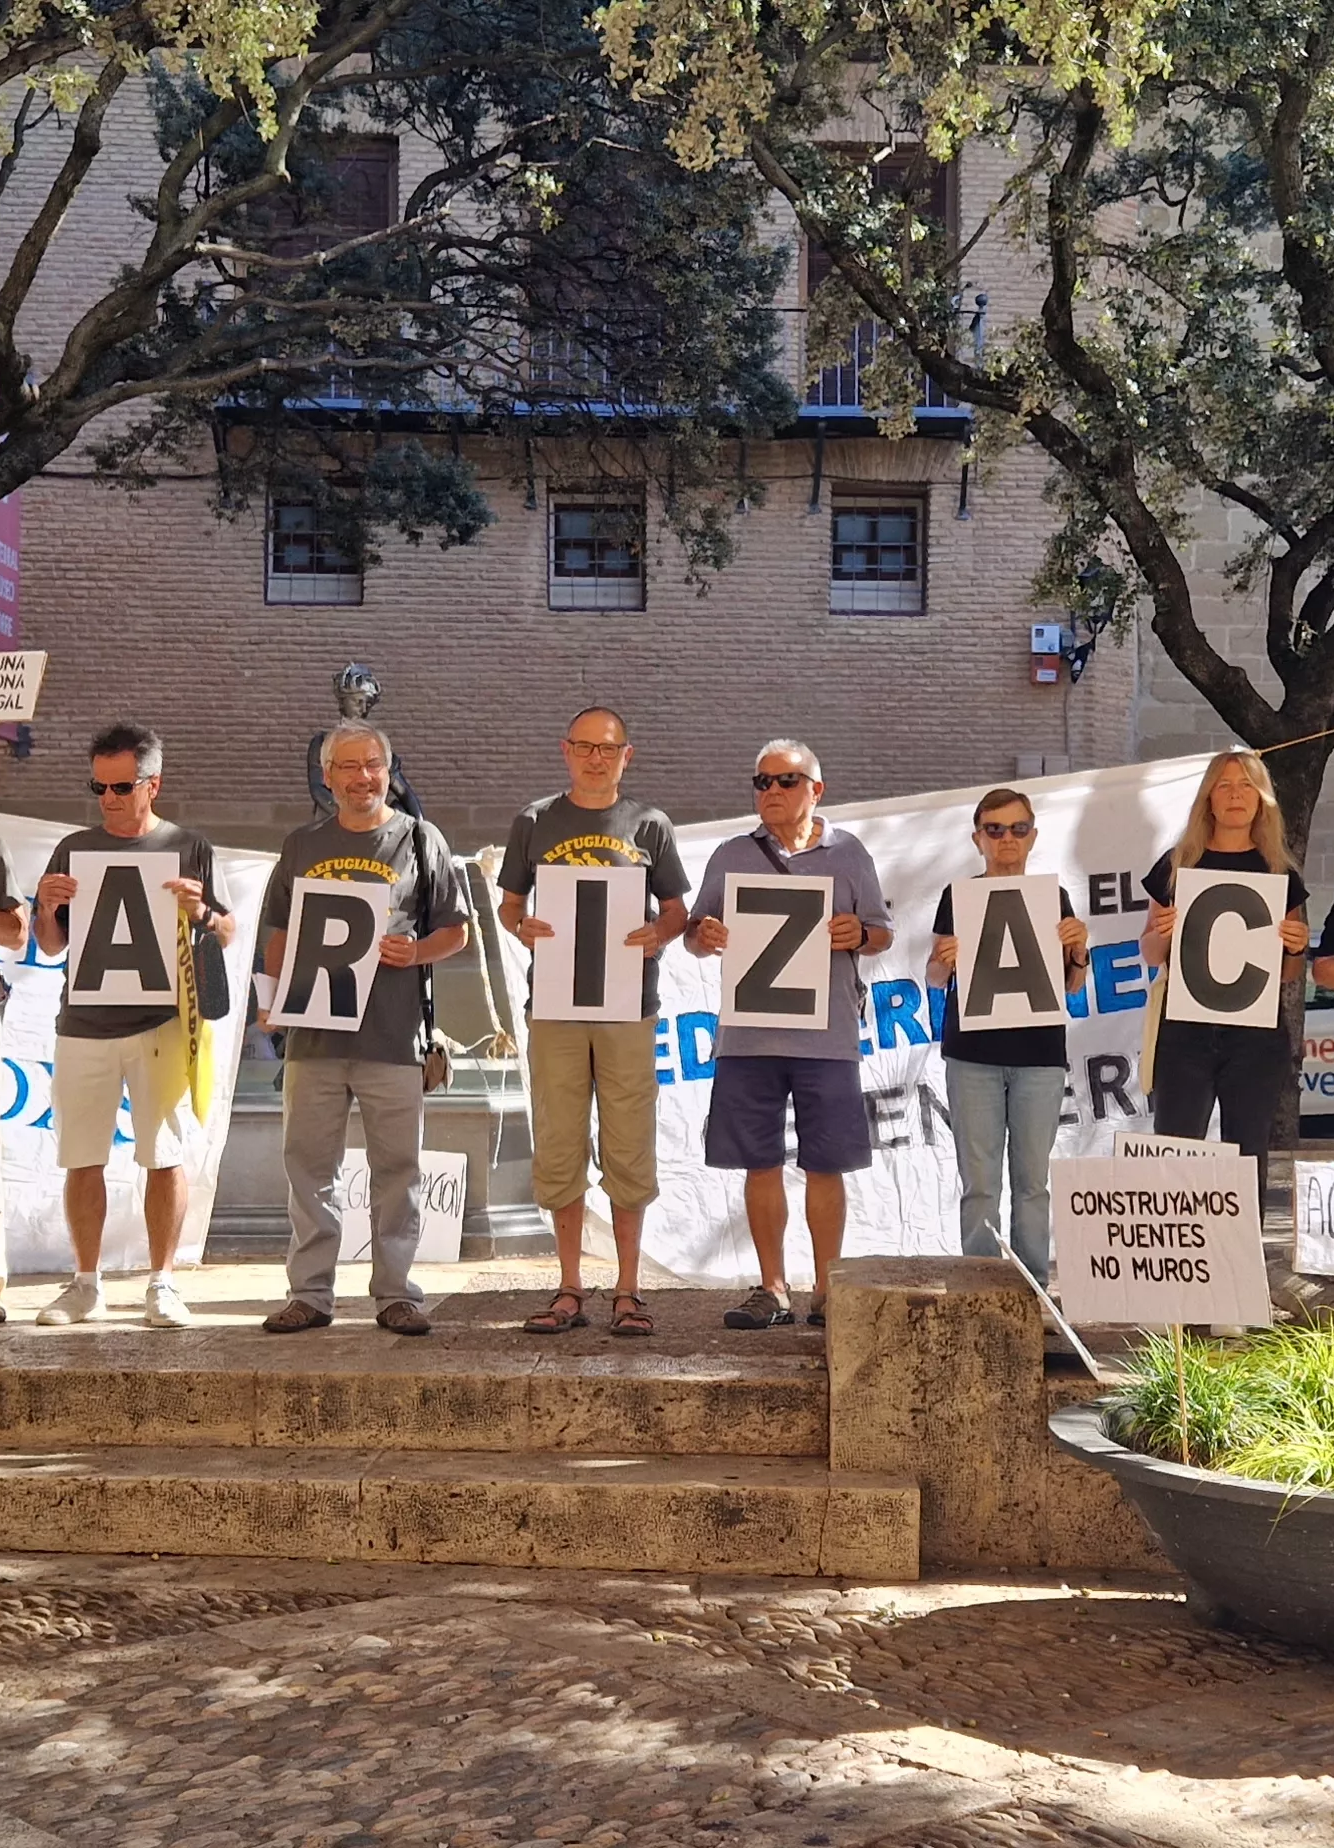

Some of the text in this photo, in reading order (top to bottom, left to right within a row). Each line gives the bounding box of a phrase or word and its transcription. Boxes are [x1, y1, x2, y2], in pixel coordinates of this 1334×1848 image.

[543, 834, 642, 864] REFUGIADXS
[1070, 1191, 1240, 1216] CONSTRUYAMOS
[1107, 1222, 1206, 1248] PUENTES
[1090, 1255, 1210, 1283] NO MUROS
